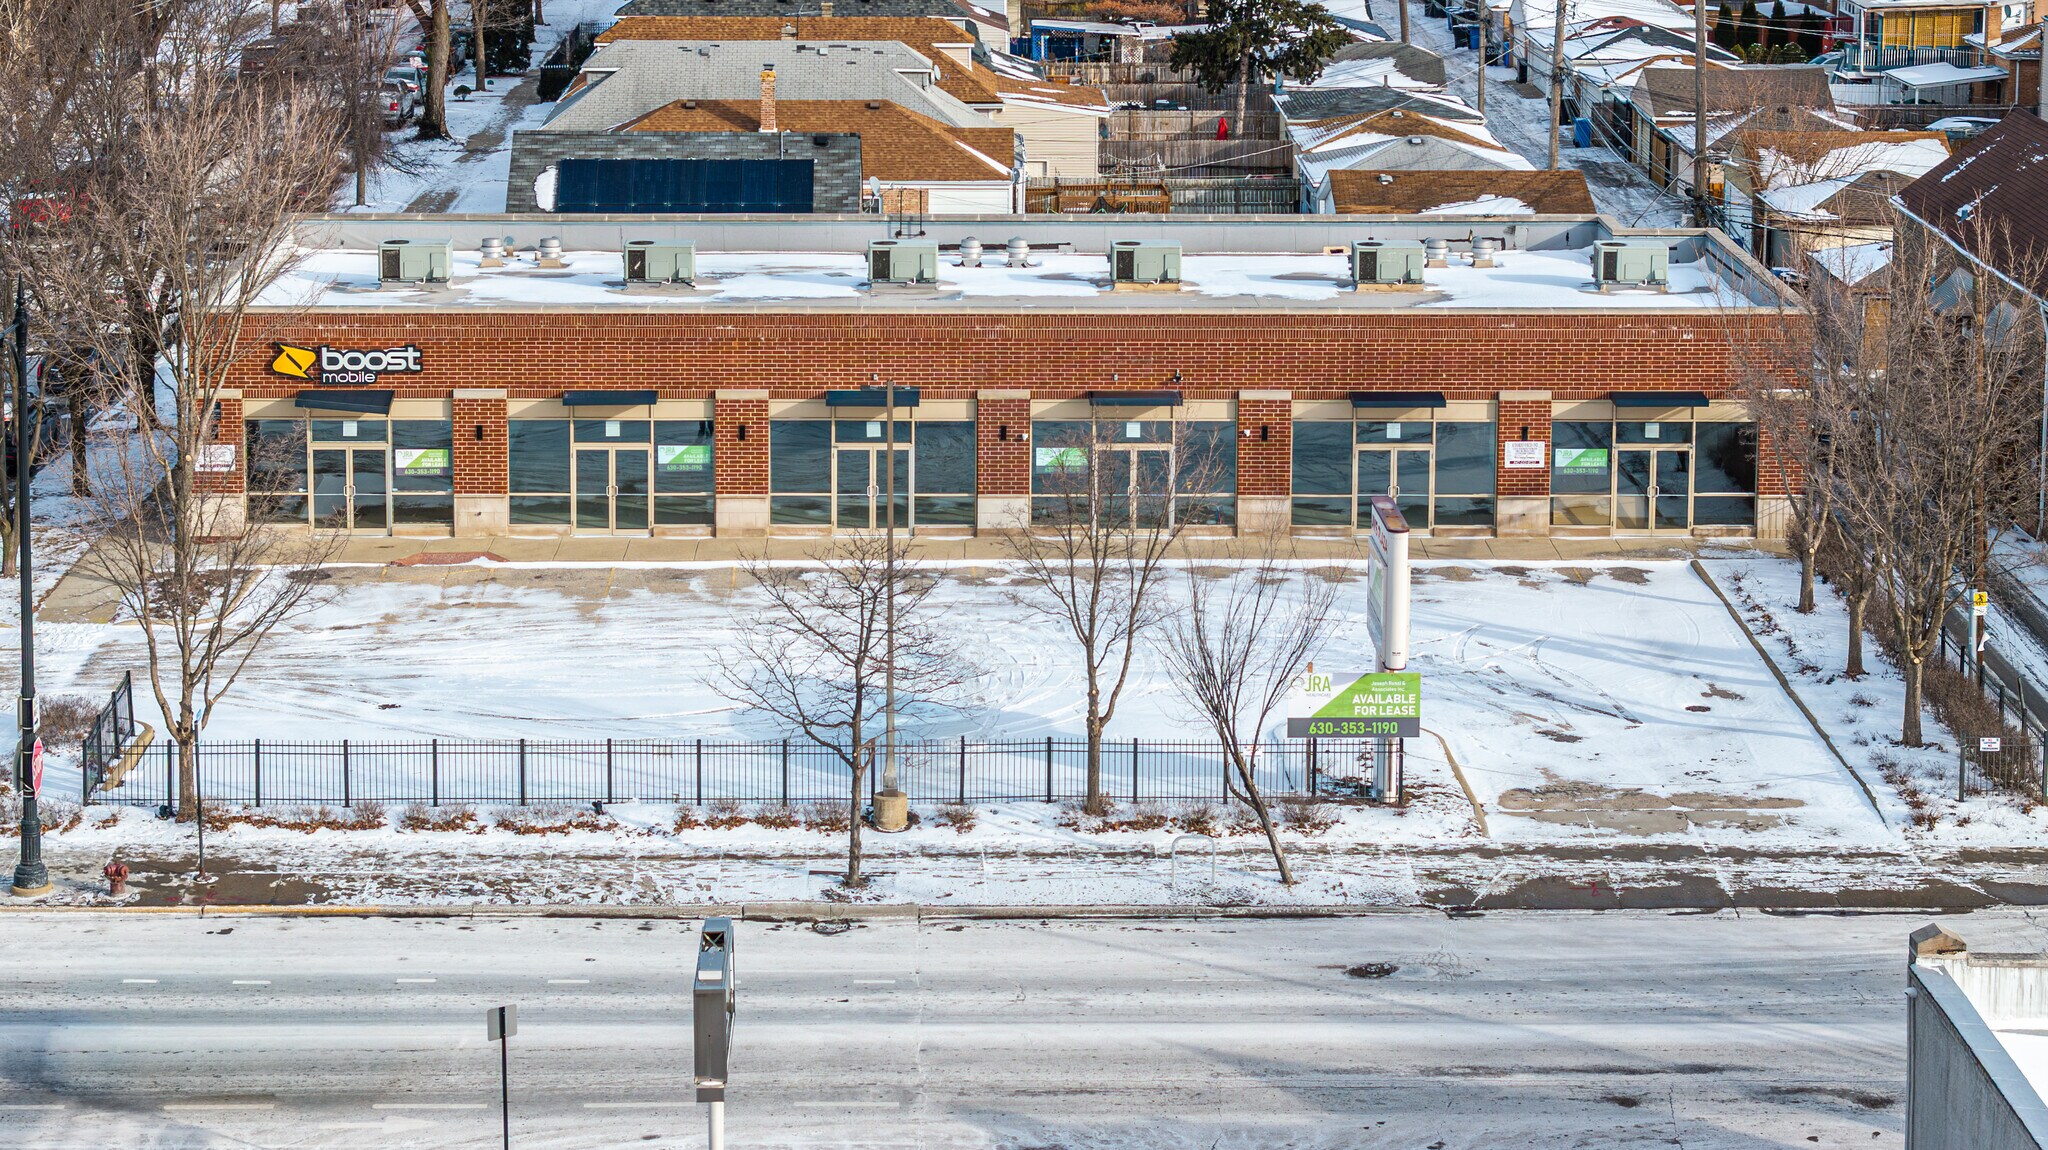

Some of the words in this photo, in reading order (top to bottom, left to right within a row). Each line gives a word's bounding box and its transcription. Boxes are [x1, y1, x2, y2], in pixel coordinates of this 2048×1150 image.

[321, 346, 421, 371] boost
[322, 371, 376, 383] mobile
[1304, 675, 1332, 692] JRA
[1352, 694, 1416, 704] AVAILABLE
[1354, 705, 1377, 716] FOR
[1379, 705, 1416, 716] LEASE
[1309, 721, 1398, 735] 630-353-1190
